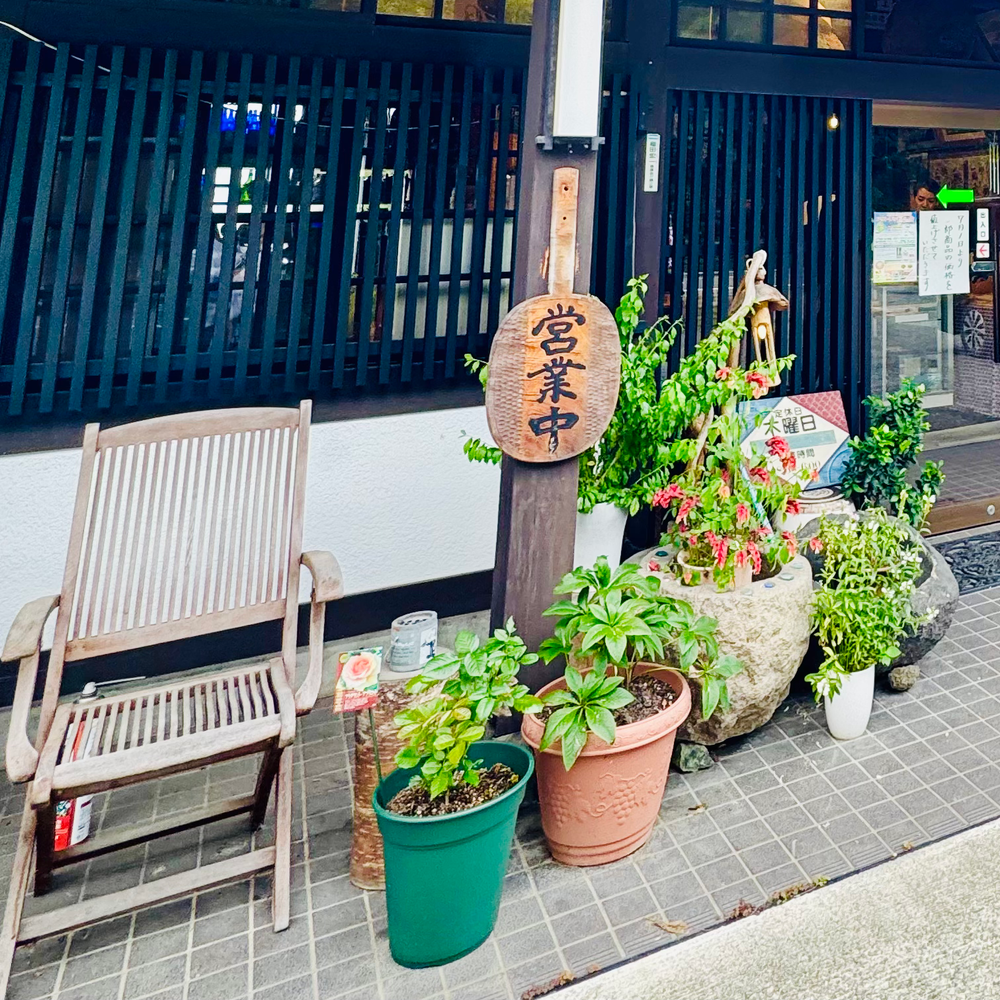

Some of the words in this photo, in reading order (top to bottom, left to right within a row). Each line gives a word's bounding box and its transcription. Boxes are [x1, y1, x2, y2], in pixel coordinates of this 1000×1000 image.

[526, 303, 586, 454] 営業中
[774, 407, 802, 418] 定休日
[763, 414, 817, 436] 木曜日
